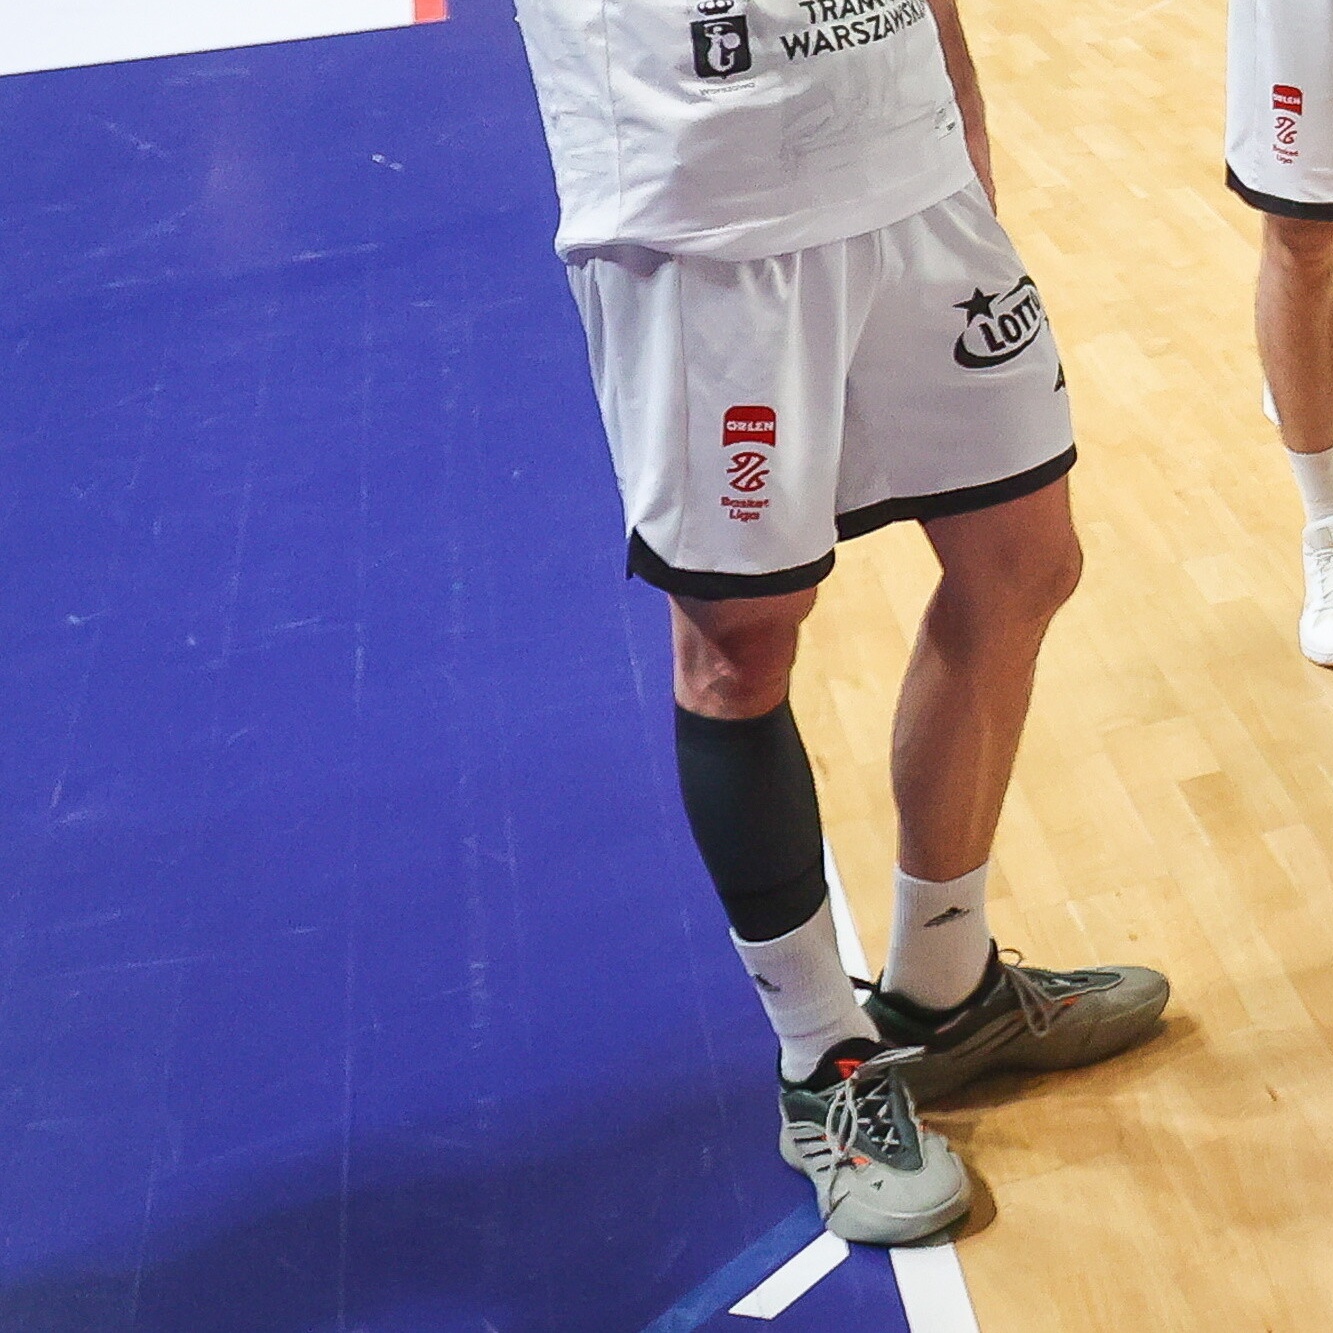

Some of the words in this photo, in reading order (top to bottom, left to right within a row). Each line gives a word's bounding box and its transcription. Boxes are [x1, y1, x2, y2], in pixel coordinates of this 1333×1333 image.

[726, 420, 775, 432] ORLEN
[721, 496, 770, 509] Basket
[729, 508, 760, 523] Liga
